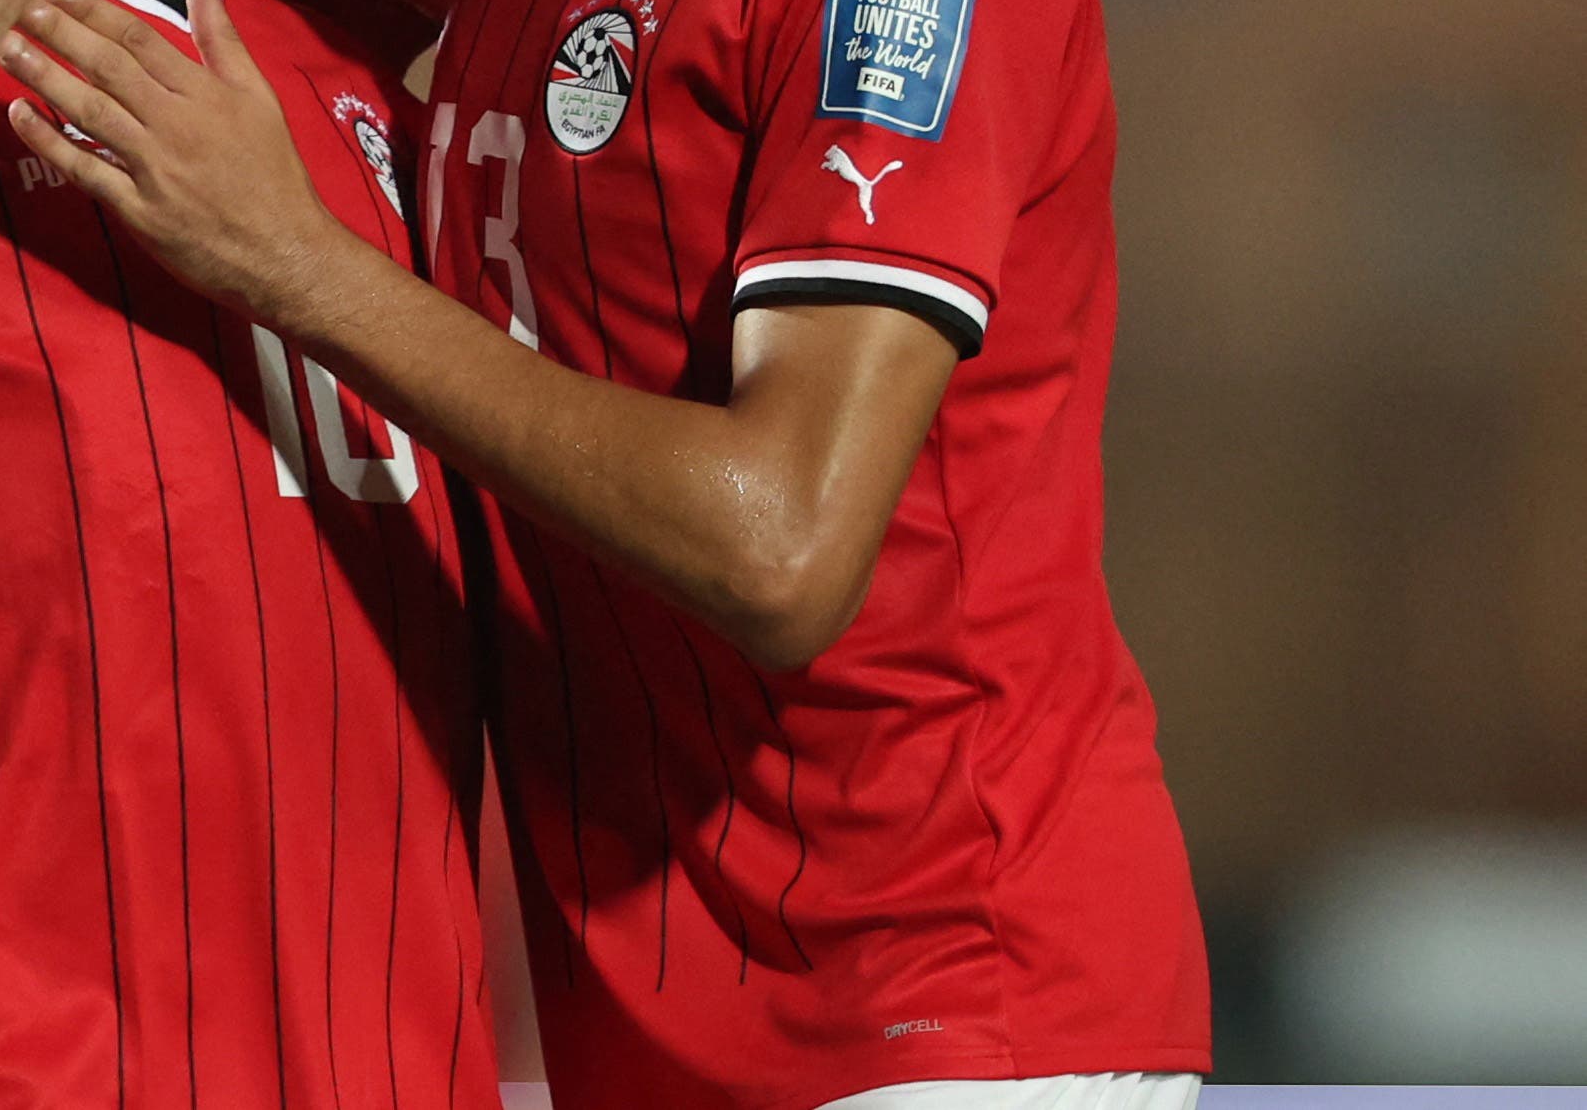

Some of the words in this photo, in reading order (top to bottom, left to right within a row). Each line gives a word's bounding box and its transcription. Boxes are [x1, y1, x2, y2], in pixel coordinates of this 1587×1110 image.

[854, 5, 938, 49] UNITES
[845, 36, 873, 61] the
[875, 40, 935, 79] World
[863, 73, 896, 93] FIFA
[884, 1018, 944, 1040] DRYCELL
